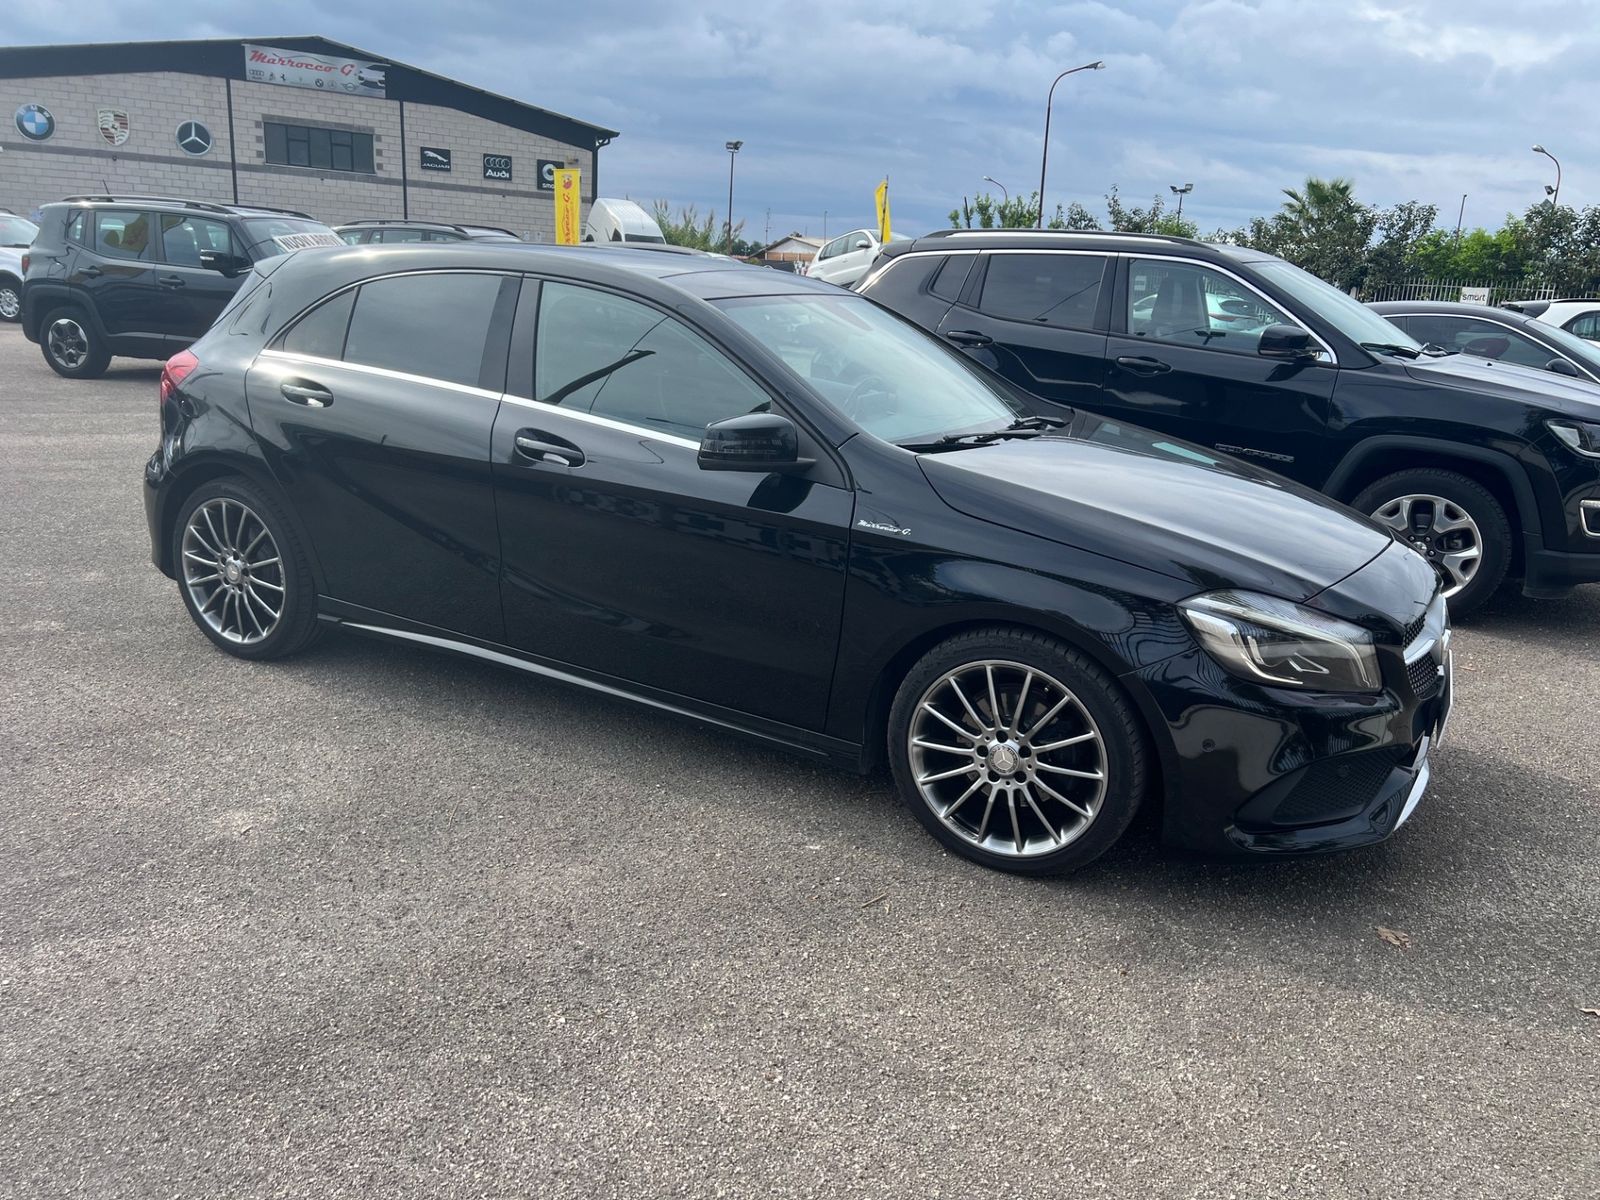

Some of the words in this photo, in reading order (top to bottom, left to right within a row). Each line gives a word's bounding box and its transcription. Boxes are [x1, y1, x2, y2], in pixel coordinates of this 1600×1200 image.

[249, 50, 338, 73] Marrocco
[485, 168, 510, 178] Audi
[1462, 294, 1486, 302] smart
